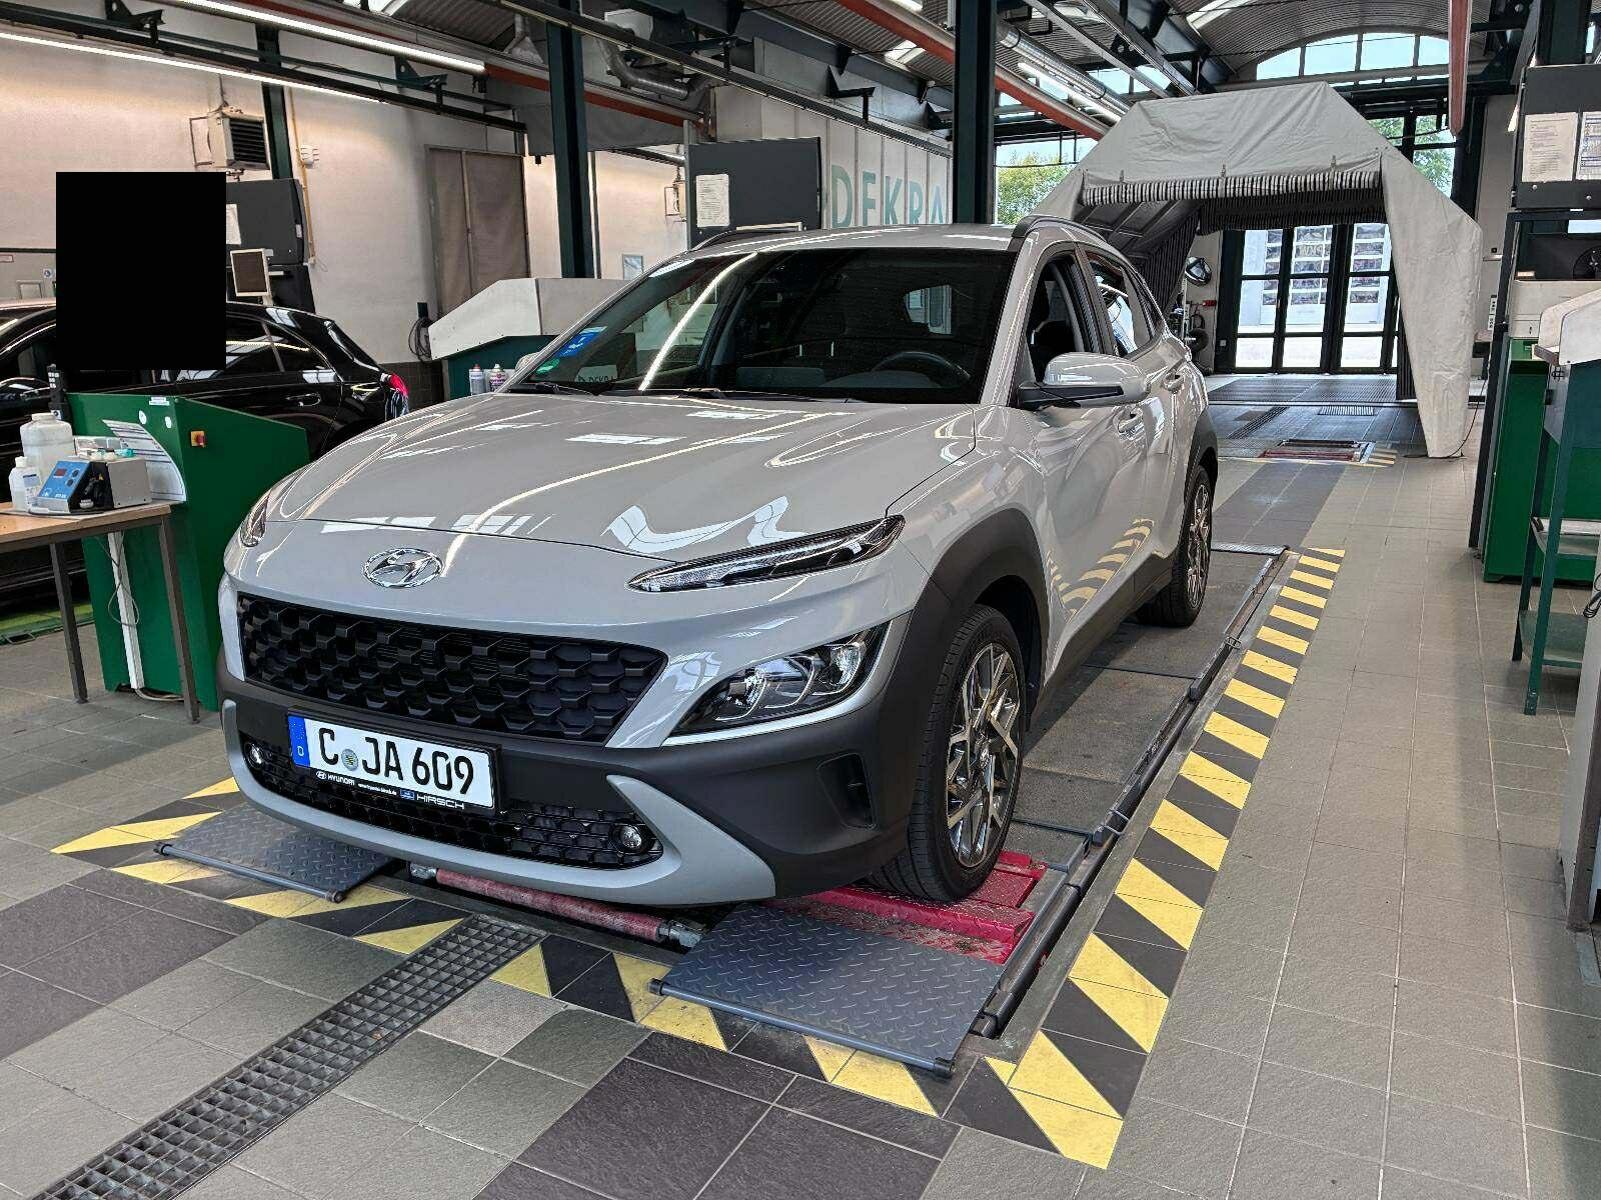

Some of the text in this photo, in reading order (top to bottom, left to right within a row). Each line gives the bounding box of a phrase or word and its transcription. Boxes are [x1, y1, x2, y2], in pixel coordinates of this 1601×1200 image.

[831, 164, 944, 228] DEKRA
[318, 727, 474, 795] C JA 609
[327, 773, 355, 786] HYUNDAI
[416, 793, 465, 810] HIRSCH
